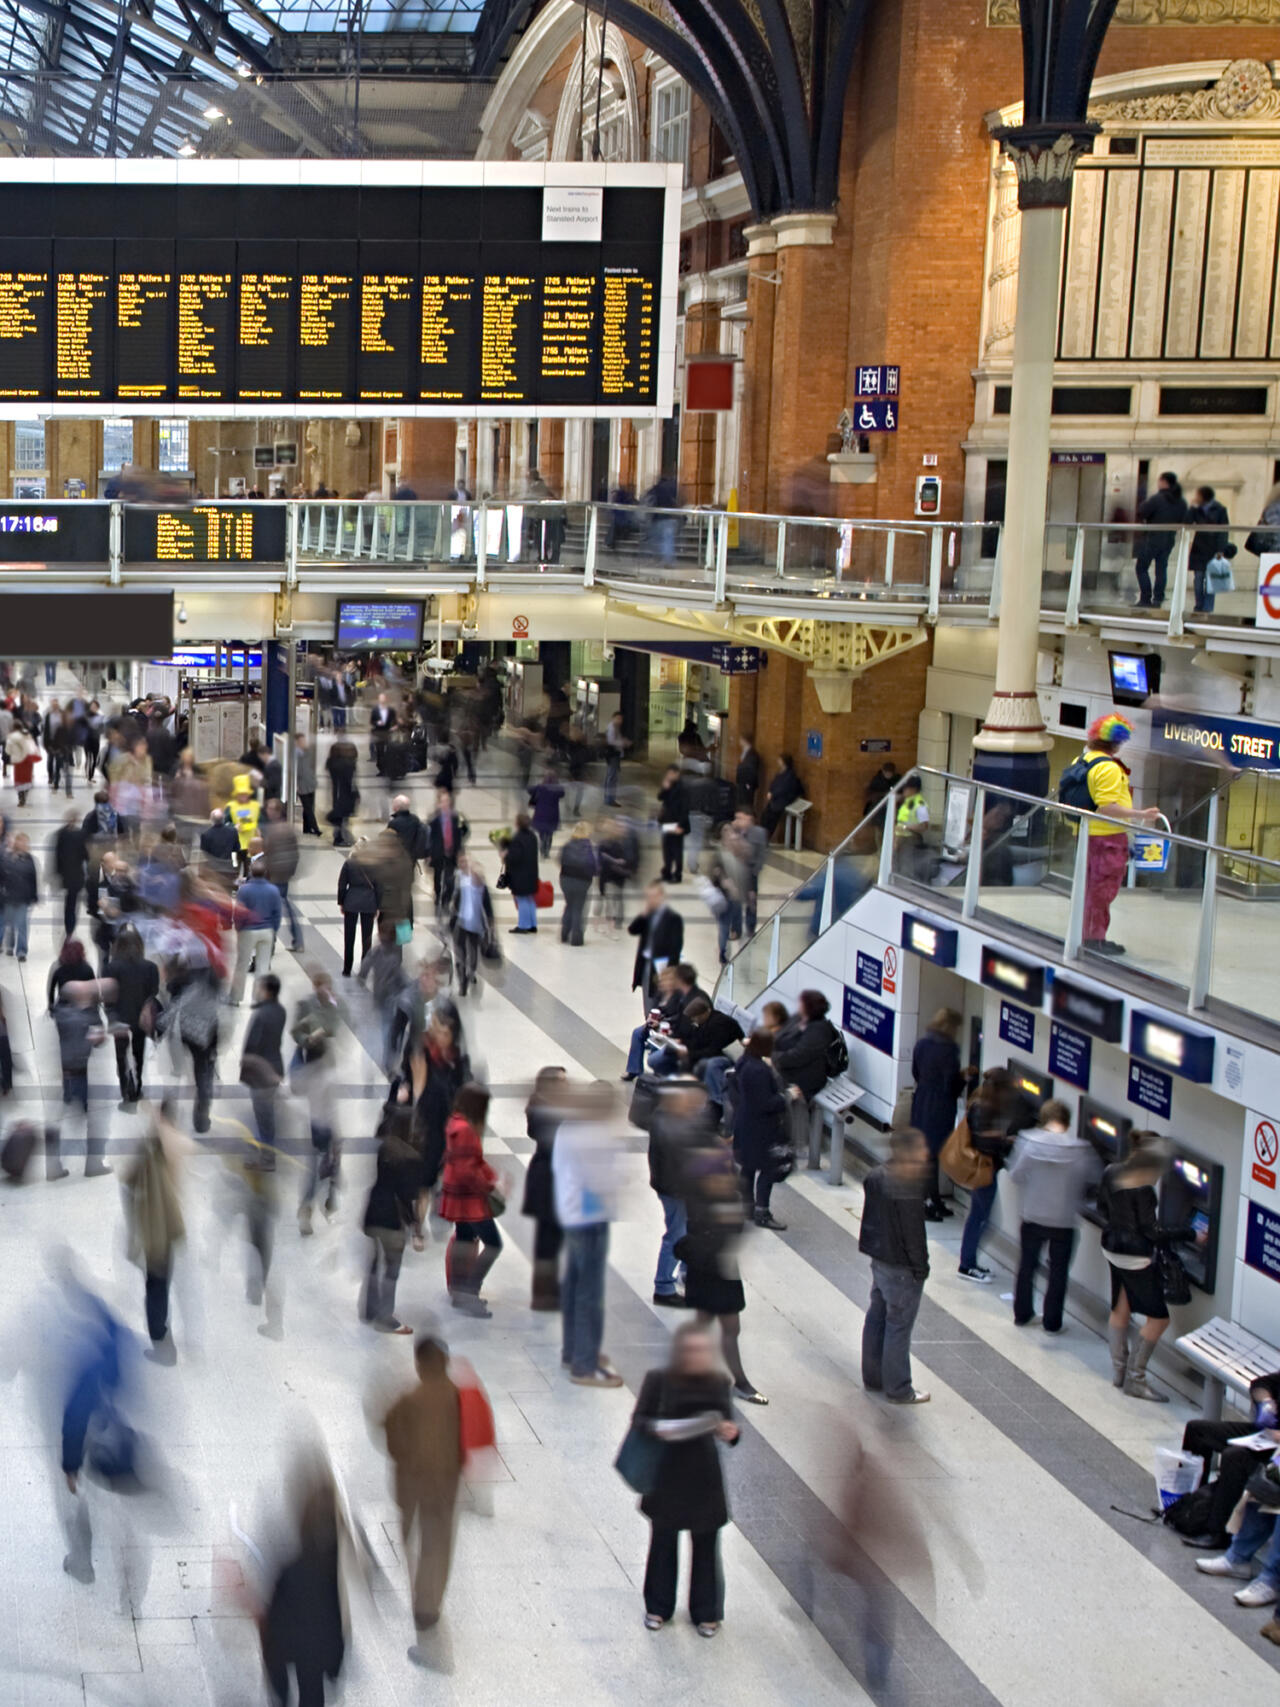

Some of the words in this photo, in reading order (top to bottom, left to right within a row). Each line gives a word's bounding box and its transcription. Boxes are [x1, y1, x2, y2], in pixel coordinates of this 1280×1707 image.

[79, 274, 103, 282] Platform
[263, 275, 287, 283] Platform
[384, 276, 408, 284] Platform
[445, 276, 469, 284] Platform
[566, 277, 589, 285] Platform
[565, 312, 589, 320] Platform
[564, 347, 587, 355] Platform
[1164, 722, 1224, 750] LIVERPOOL
[1230, 734, 1274, 759] STREET
